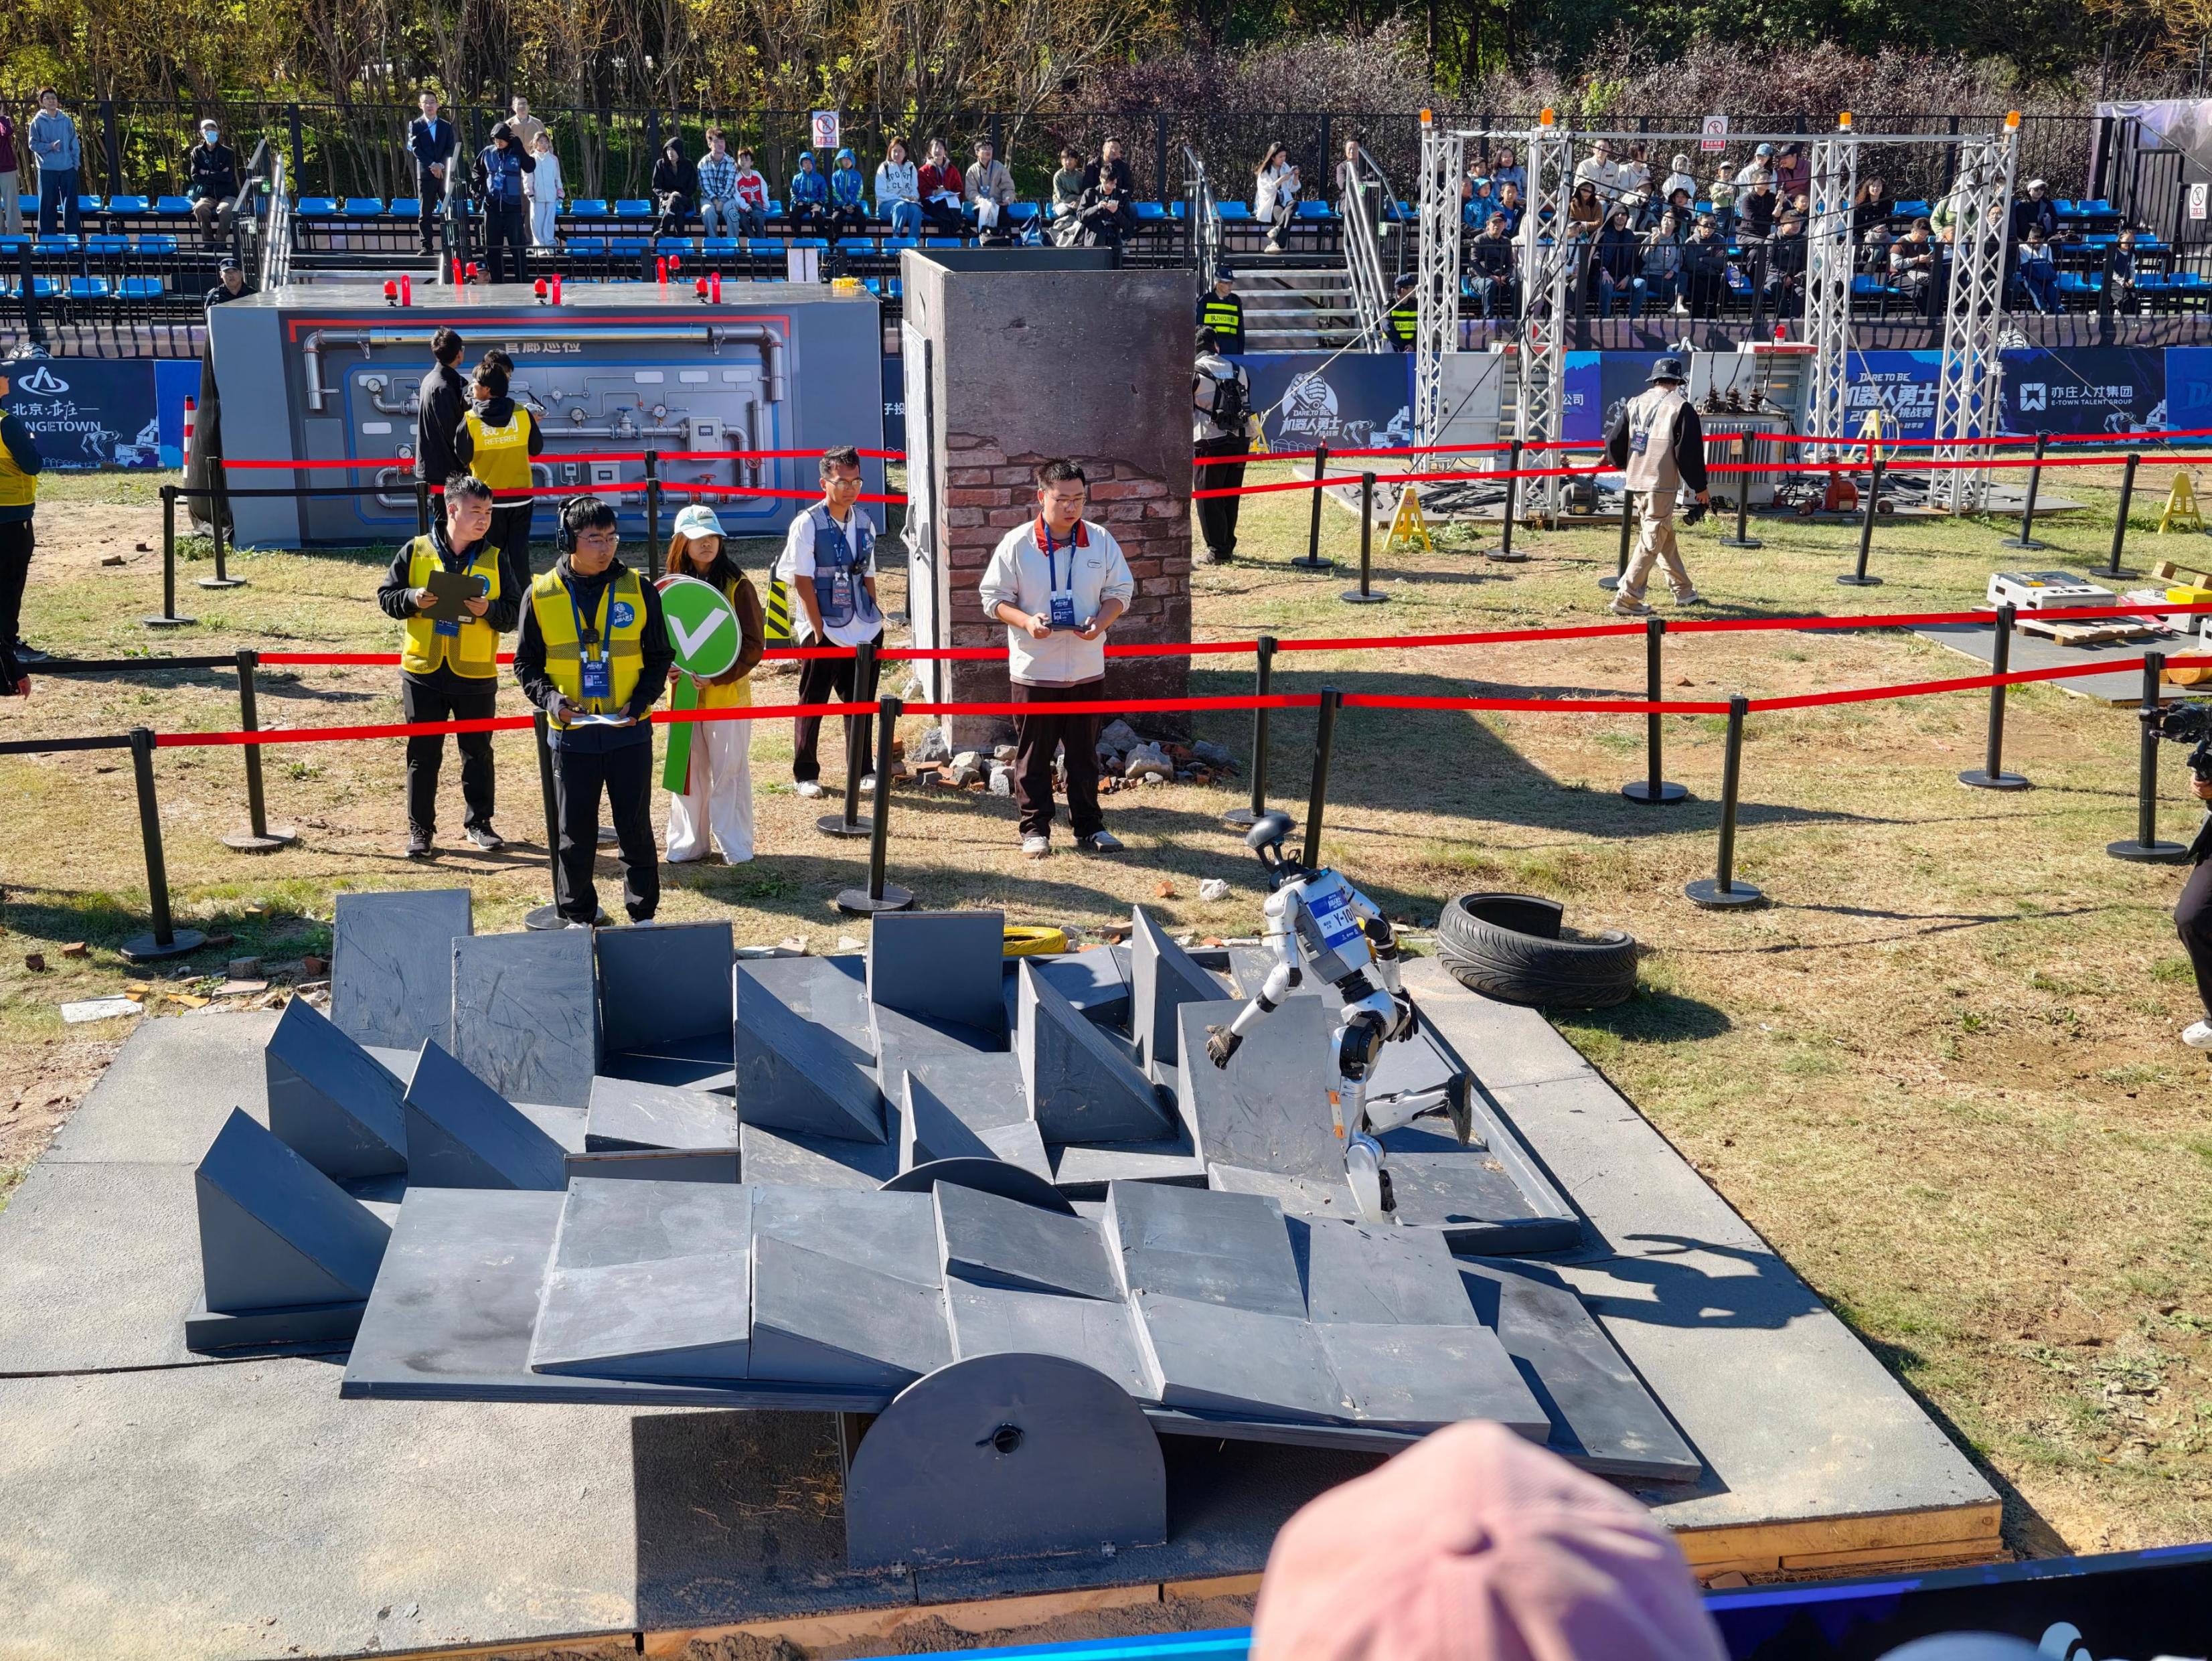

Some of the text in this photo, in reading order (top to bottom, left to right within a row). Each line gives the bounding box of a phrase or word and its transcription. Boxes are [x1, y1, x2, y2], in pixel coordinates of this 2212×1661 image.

[1857, 372, 1912, 383] DARE TO BE
[2051, 386, 2133, 398] 亦庄人才集团
[1563, 394, 1583, 406] 公司
[1844, 381, 1940, 416] 机器人勇士
[1846, 409, 1889, 423] 206
[1898, 407, 1934, 418] 挑战赛
[1279, 416, 1343, 437] 机器人勇士
[484, 434, 520, 447] REFEREE
